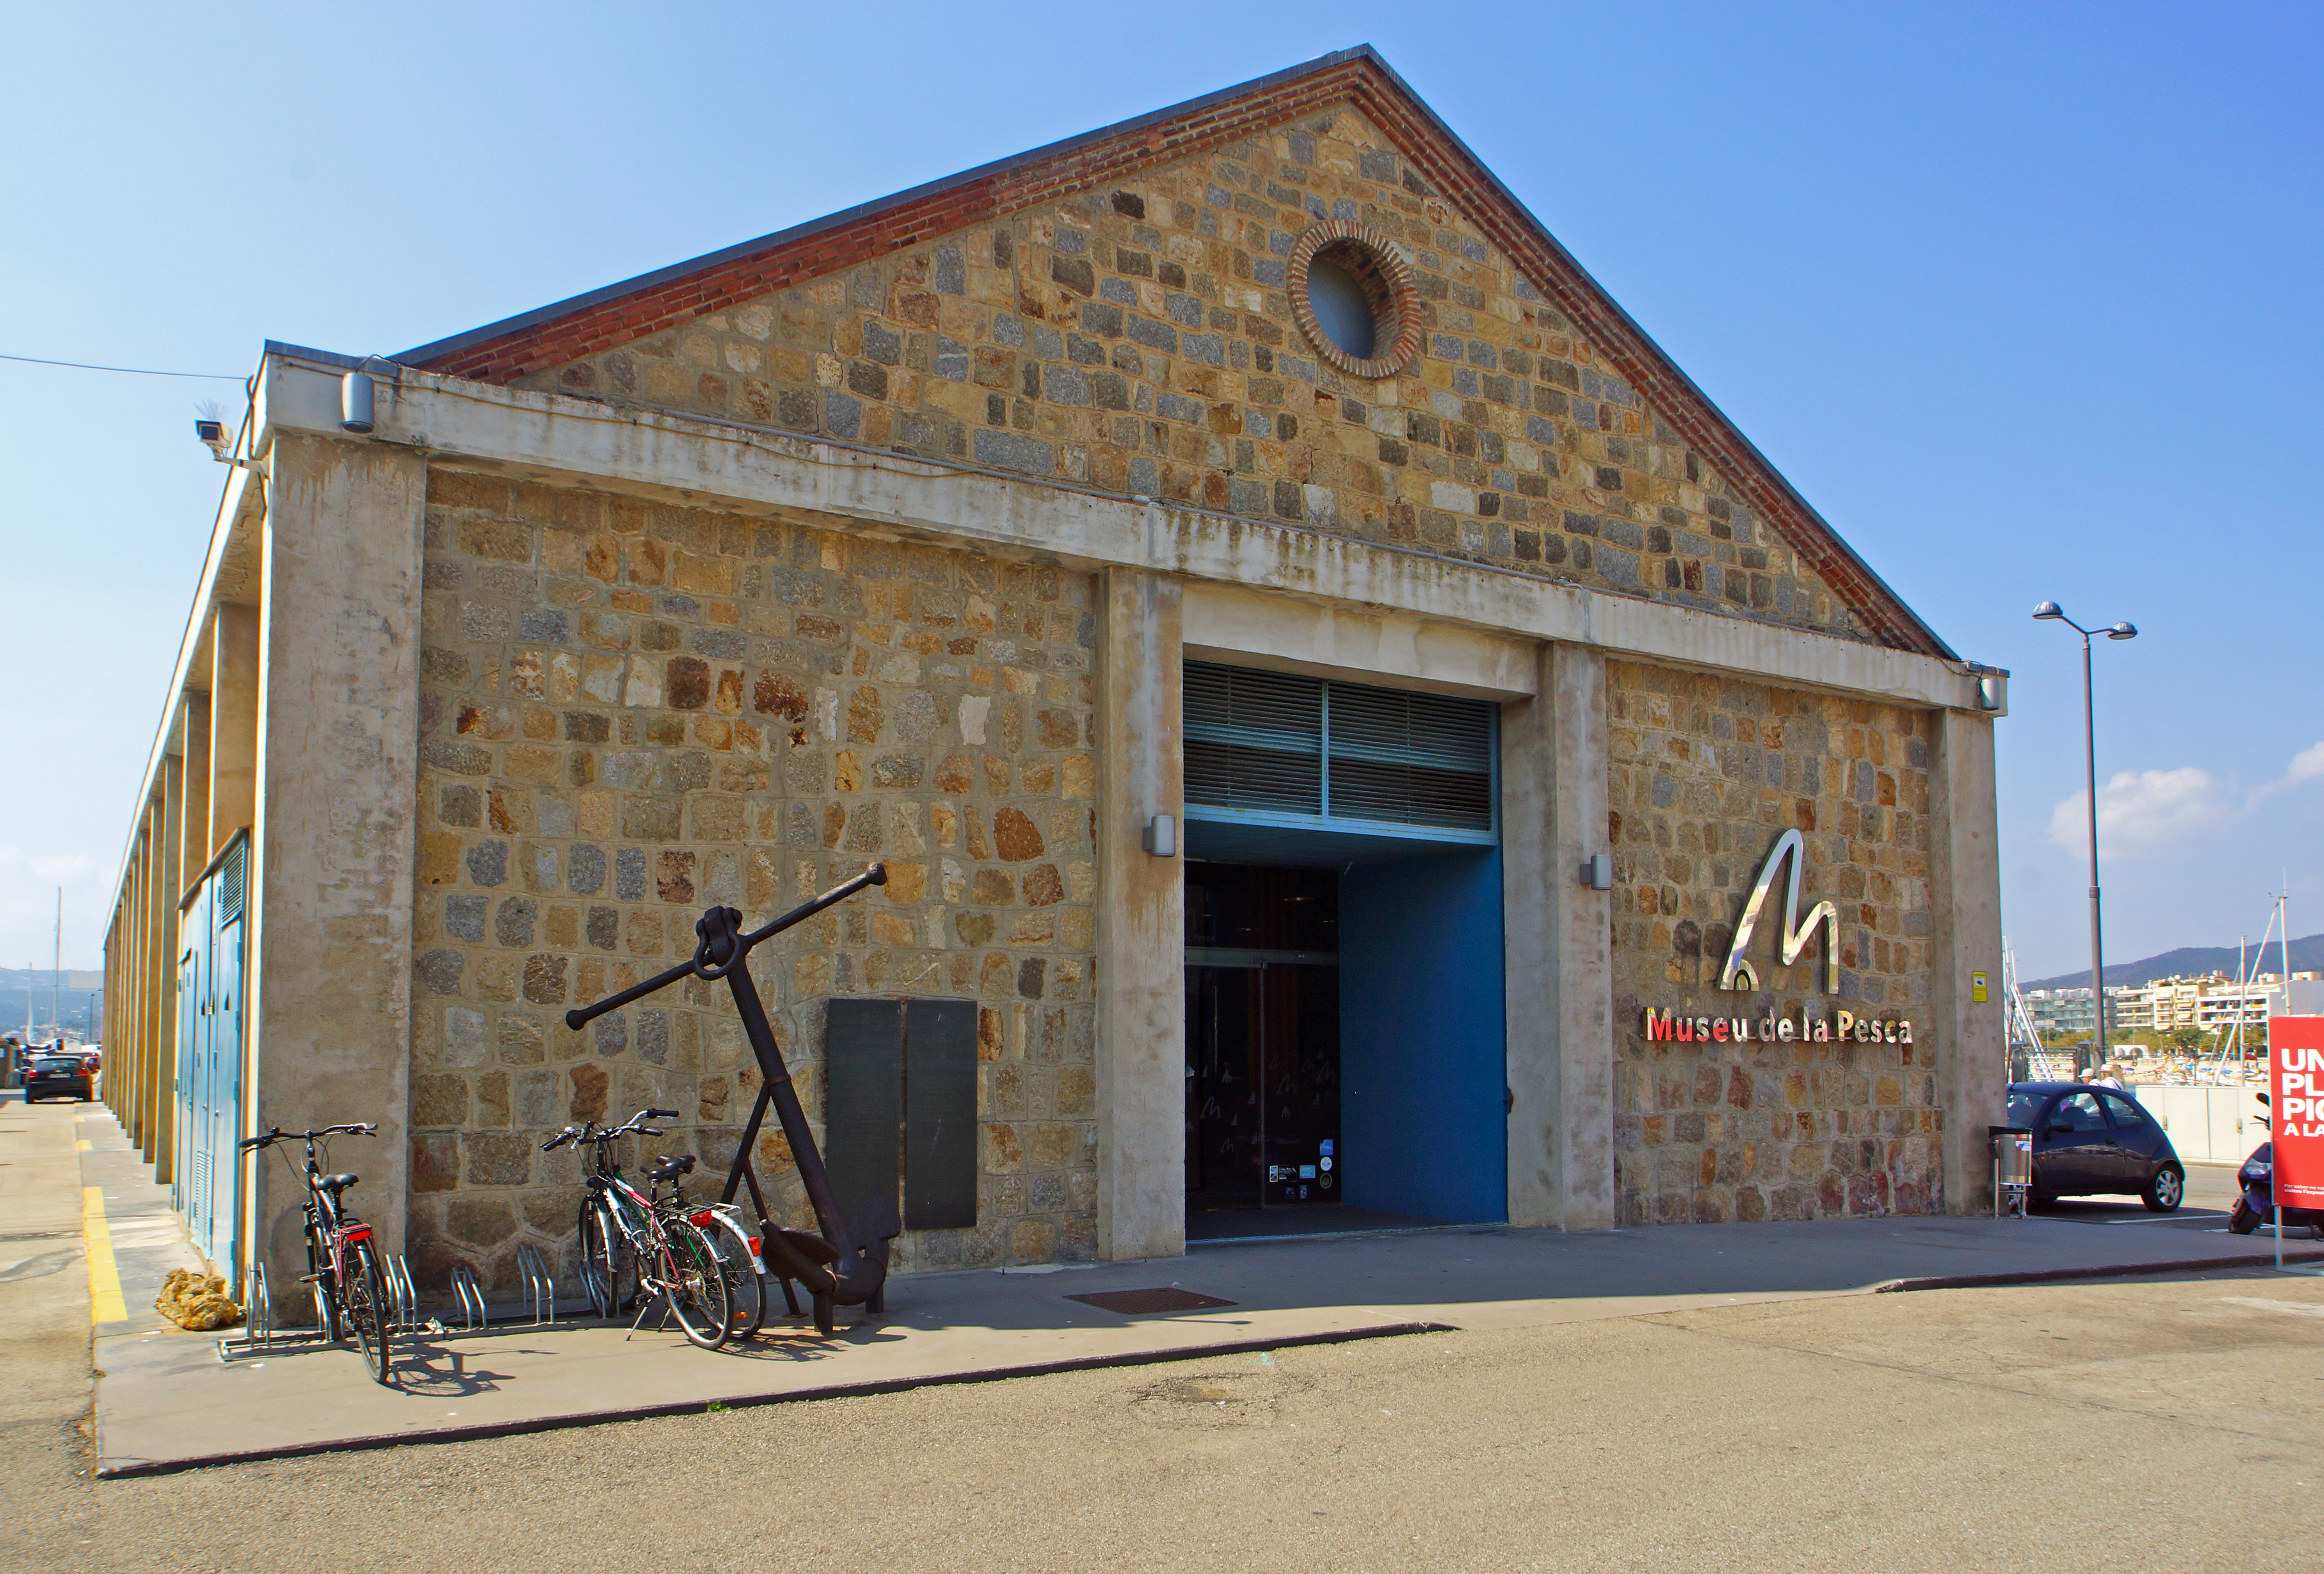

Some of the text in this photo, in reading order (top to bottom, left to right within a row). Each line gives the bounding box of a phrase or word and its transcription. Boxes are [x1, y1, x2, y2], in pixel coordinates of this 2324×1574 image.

[1646, 1006, 1913, 1044] Museu de la Pesca
[2283, 1122, 2300, 1136] A
